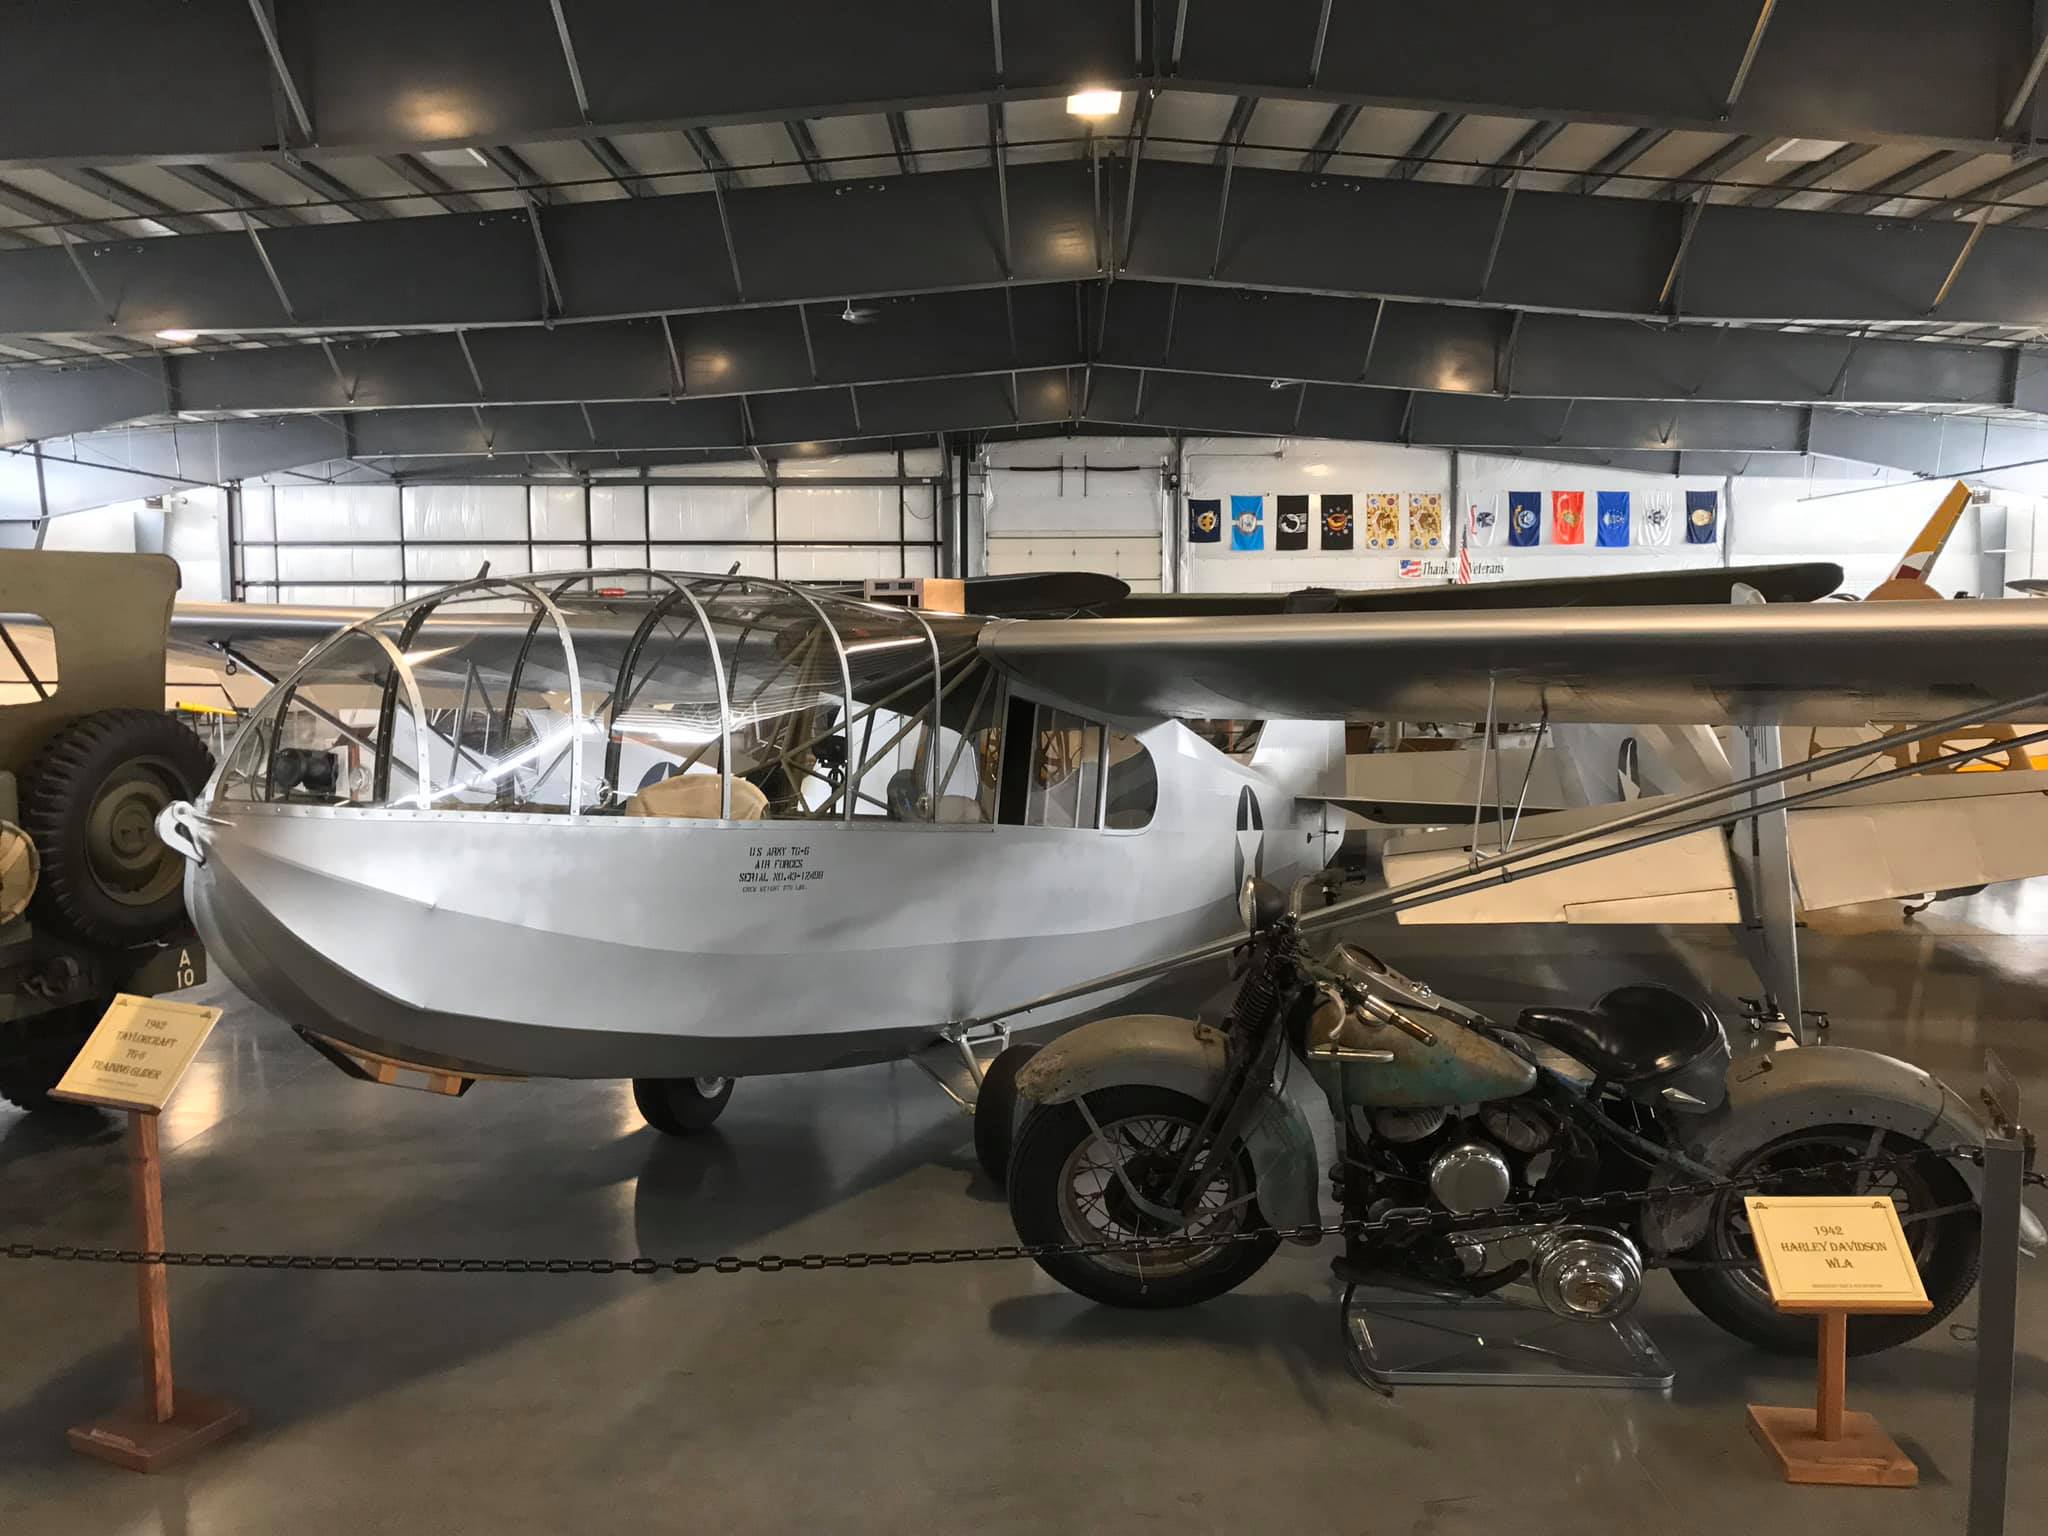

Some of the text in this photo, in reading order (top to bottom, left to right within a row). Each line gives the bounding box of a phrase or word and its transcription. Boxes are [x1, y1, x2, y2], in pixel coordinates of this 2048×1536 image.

[1423, 561, 1449, 576] Thank
[767, 847, 786, 857] ARMY
[754, 859, 804, 869] AIR FORCES
[738, 872, 769, 882] SERIAL
[179, 949, 191, 968] A
[176, 969, 195, 988] 10
[117, 1031, 178, 1048] TAYLORCRAFT
[91, 1060, 162, 1080] TRAINING GLIDER
[1814, 1225, 1844, 1237] 1942
[1781, 1241, 1887, 1252] HARLEY DAVIDSON
[1825, 1258, 1854, 1269] WLA
